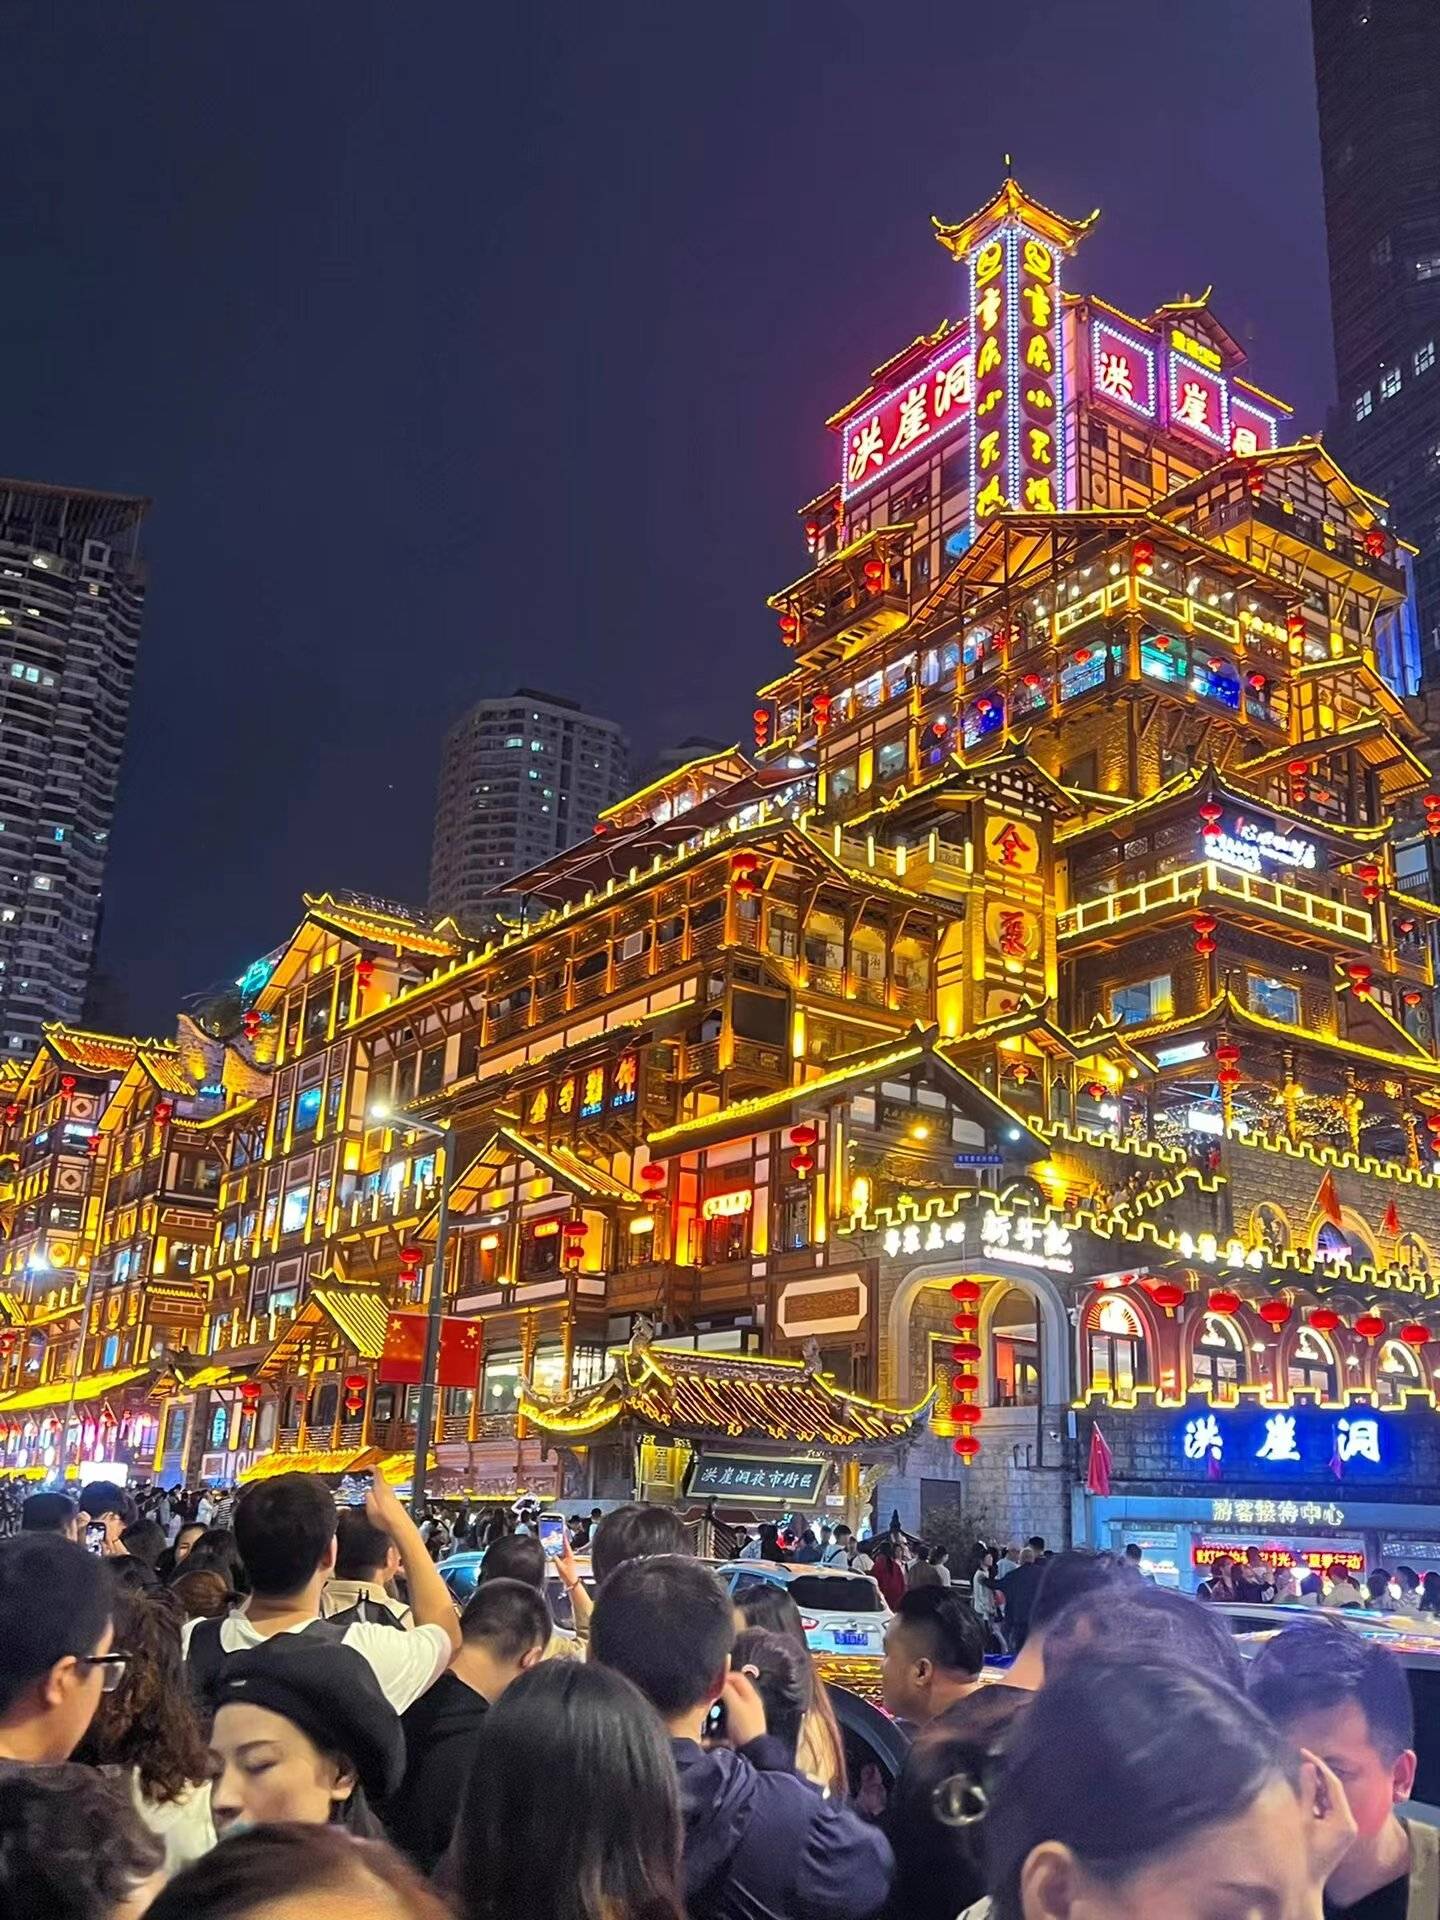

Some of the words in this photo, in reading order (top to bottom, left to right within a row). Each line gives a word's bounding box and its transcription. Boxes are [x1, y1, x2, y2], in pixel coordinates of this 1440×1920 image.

[848, 353, 975, 482] 洪崖洞
[1184, 1413, 1381, 1463] 洪崖洞
[701, 1466, 813, 1489] 洪崖洞夜市街区
[1211, 1499, 1345, 1526] 游客接待中心
